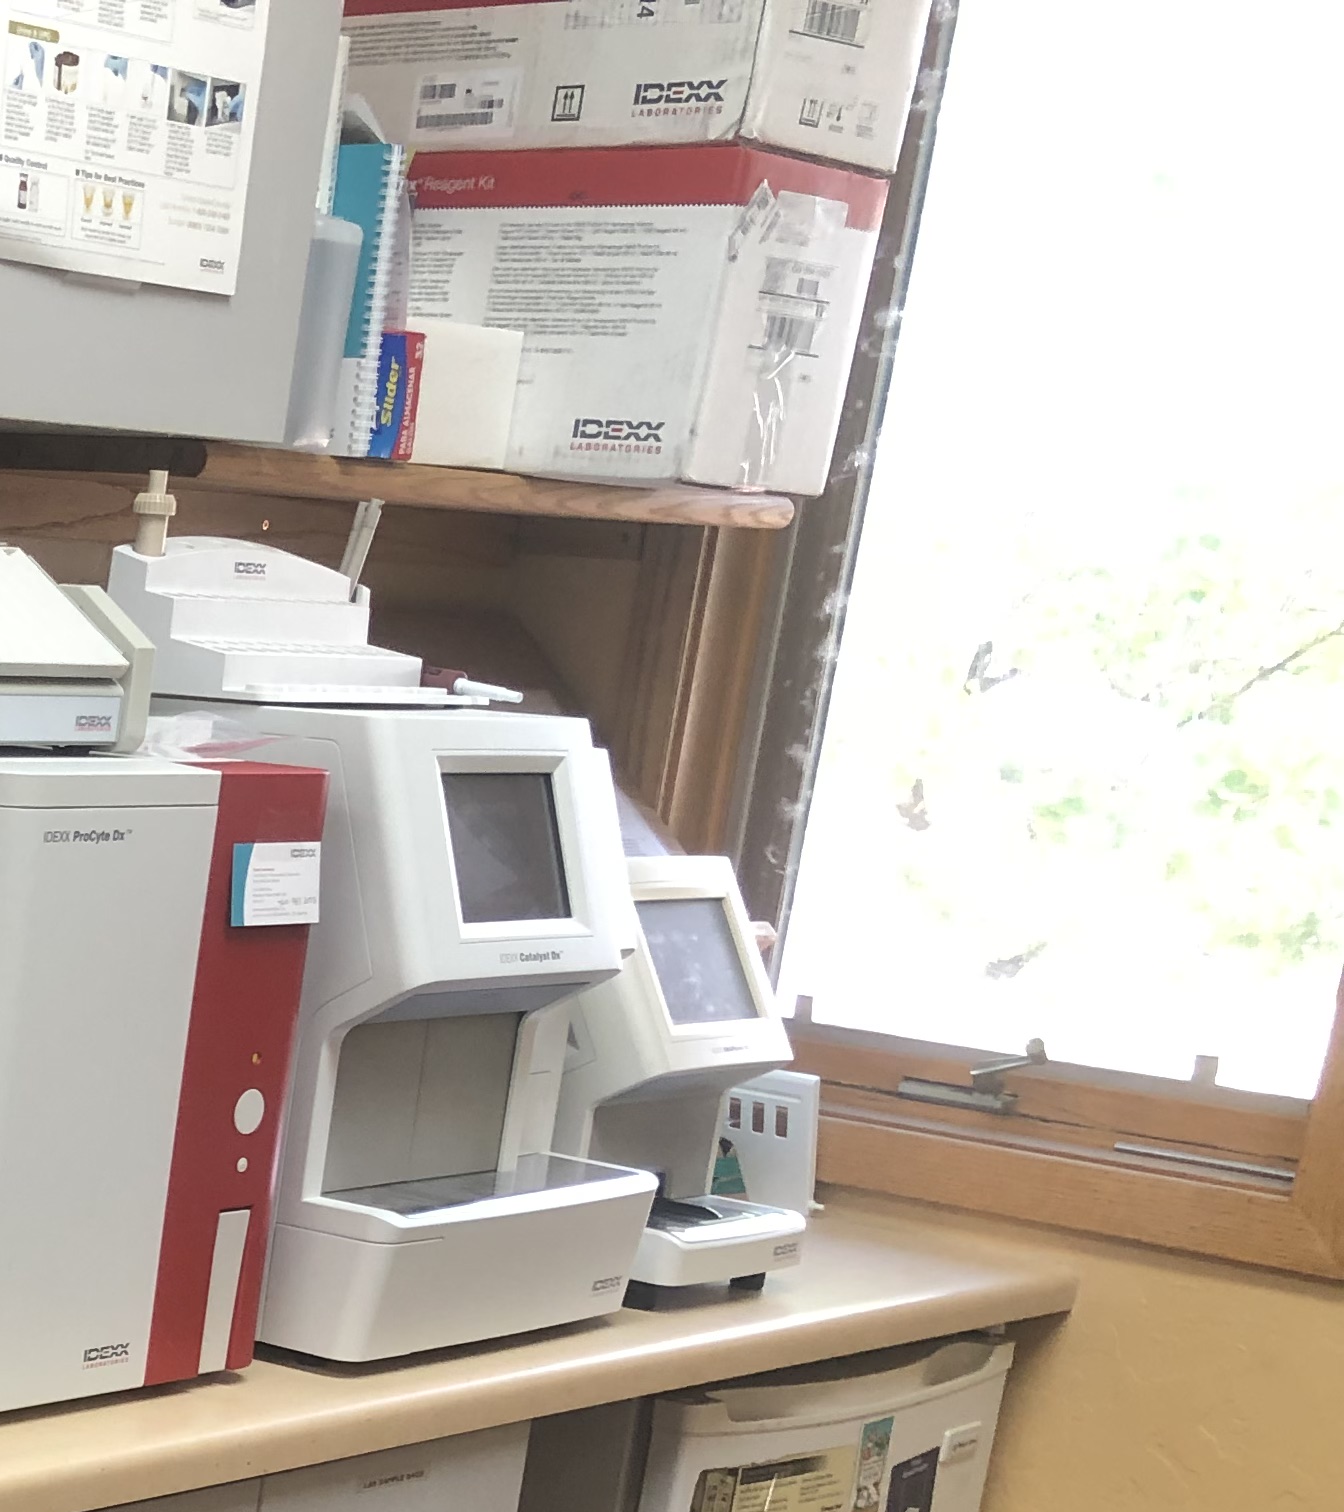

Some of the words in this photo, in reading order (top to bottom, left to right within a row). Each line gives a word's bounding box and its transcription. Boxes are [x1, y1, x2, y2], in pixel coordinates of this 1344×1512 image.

[633, 79, 728, 105] IDEXX
[631, 106, 724, 118] LABORATORIES
[424, 176, 475, 193] Reagent
[478, 176, 496, 191] Kit
[381, 356, 400, 427] Slider
[572, 418, 664, 443] IDEXX
[570, 442, 662, 455] LABORATORIES
[76, 716, 112, 727] IDEXX
[44, 831, 70, 843] IDEXX
[73, 830, 110, 844] ProCyte
[520, 952, 550, 963] Catalyst
[83, 1342, 130, 1362] IDEXX
